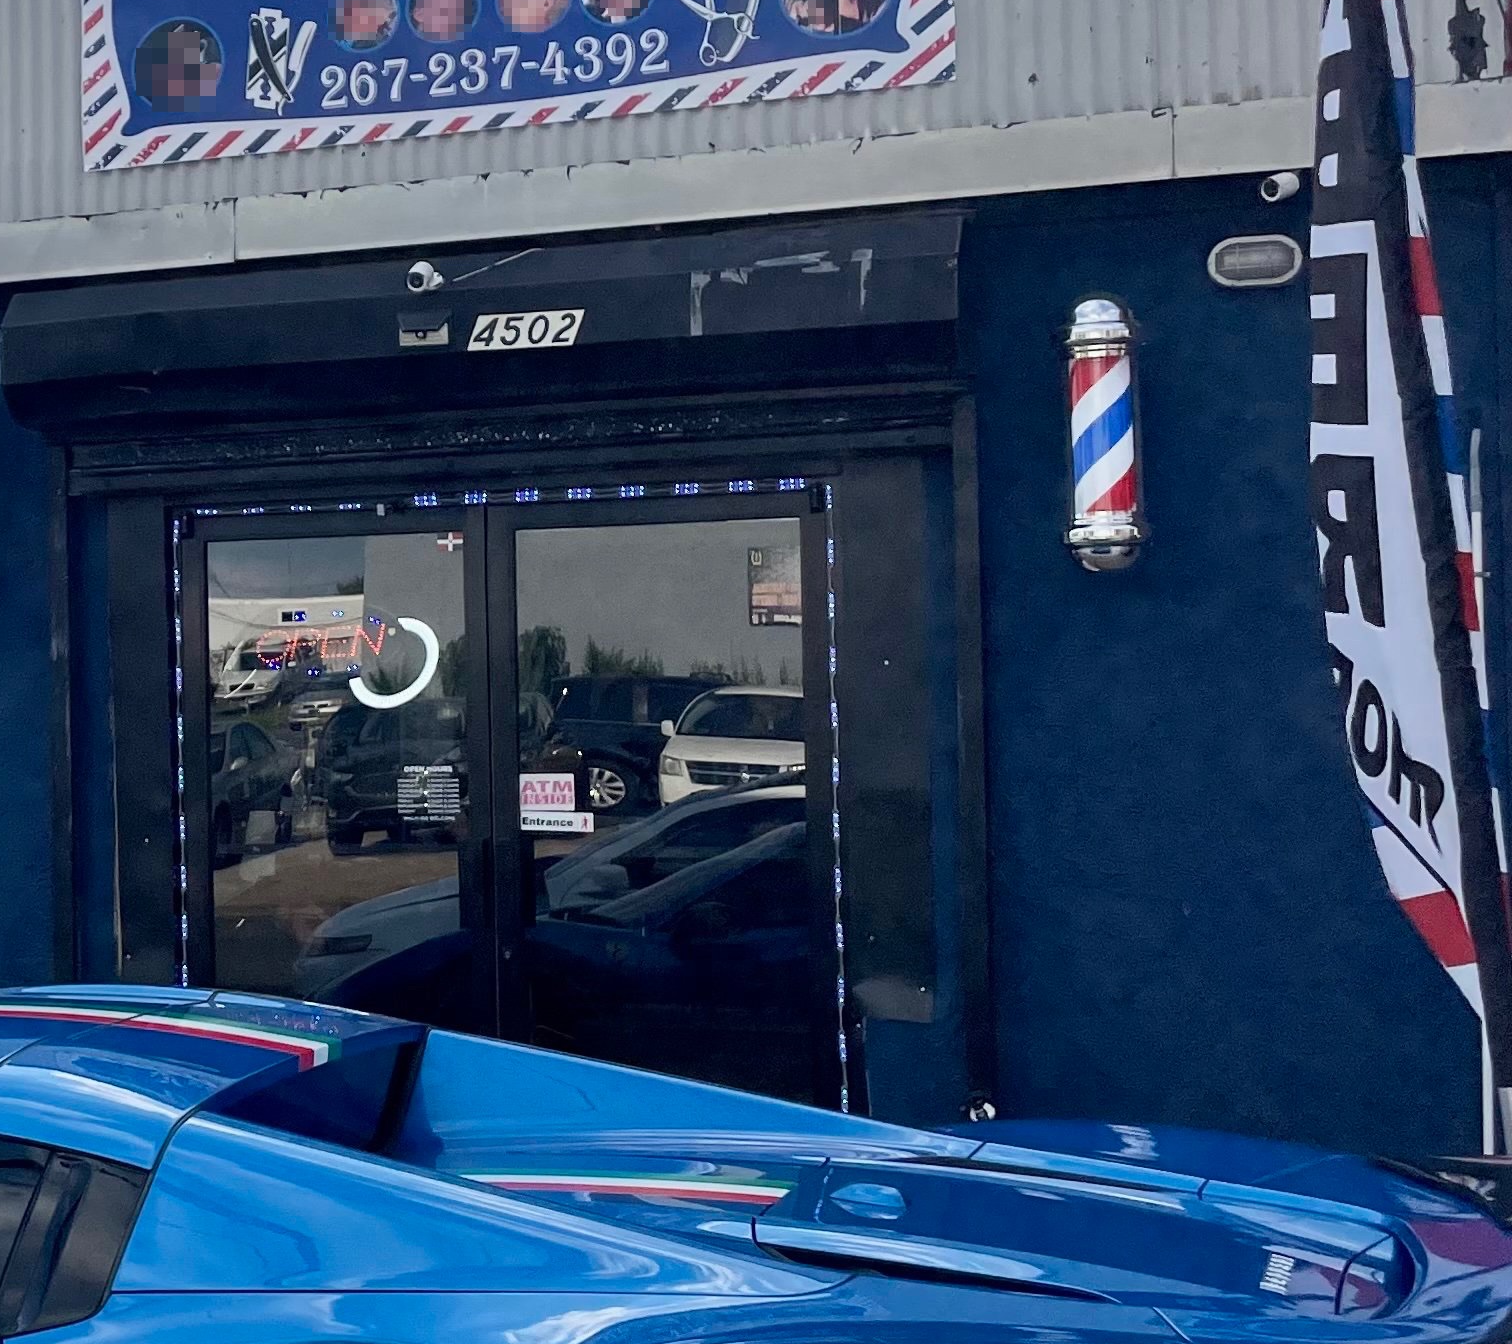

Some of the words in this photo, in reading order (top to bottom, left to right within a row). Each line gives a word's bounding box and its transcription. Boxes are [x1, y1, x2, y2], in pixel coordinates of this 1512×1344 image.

[319, 27, 671, 110] 267-237-4392
[472, 312, 577, 347] 4502
[255, 622, 386, 664] OPEN
[521, 780, 573, 793] ATM
[522, 816, 574, 827] Entrance
